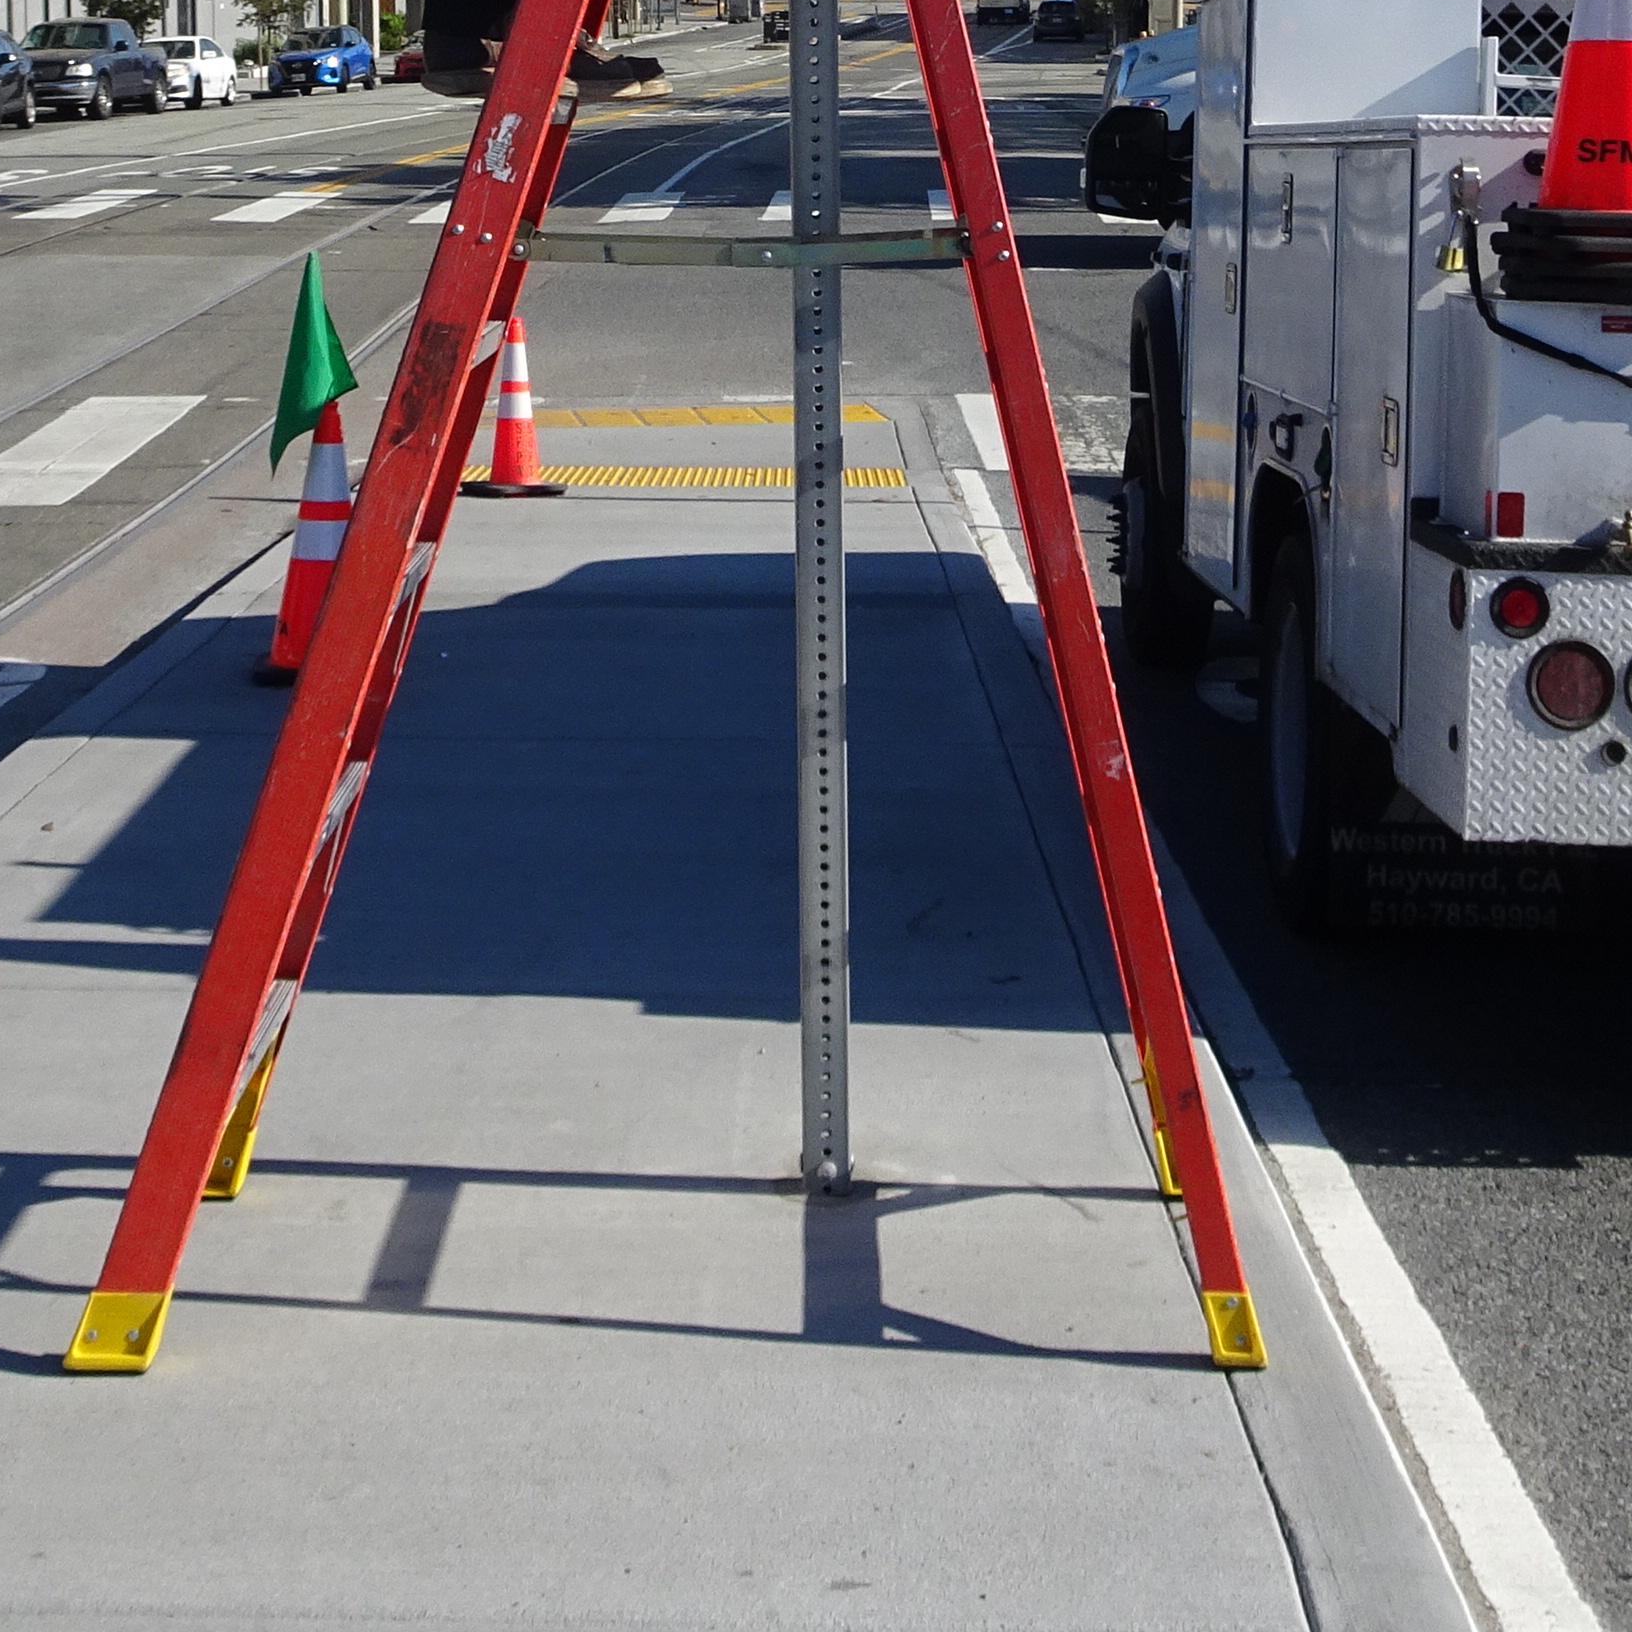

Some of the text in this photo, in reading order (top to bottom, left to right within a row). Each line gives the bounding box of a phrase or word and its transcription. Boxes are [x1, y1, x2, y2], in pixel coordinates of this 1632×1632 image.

[1330, 826, 1446, 855] Western
[1366, 863, 1563, 895] Hayward, CA
